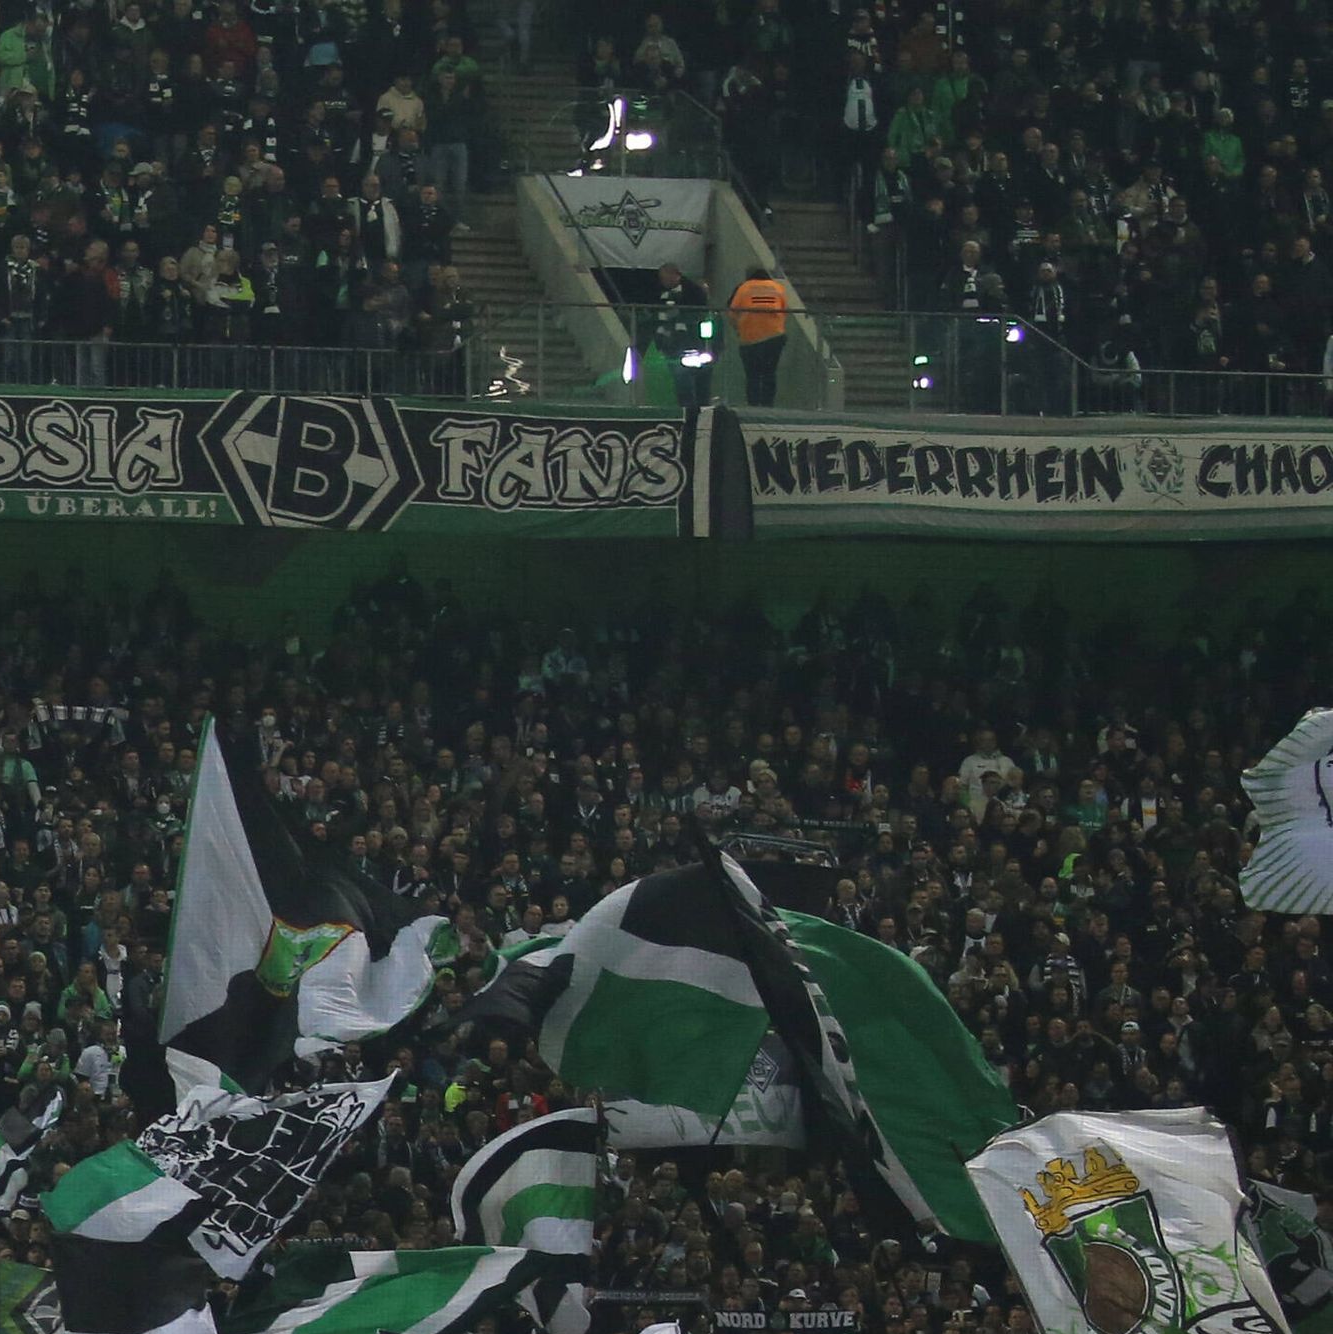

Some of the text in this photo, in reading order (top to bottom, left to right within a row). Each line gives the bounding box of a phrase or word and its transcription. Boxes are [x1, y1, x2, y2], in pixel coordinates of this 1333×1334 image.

[268, 396, 361, 523] B
[430, 417, 687, 513] FANS
[749, 435, 1127, 502] NIEDERRHEIN
[26, 490, 221, 520] ÜBERALL!
[714, 1310, 856, 1329] NORD KURVE
